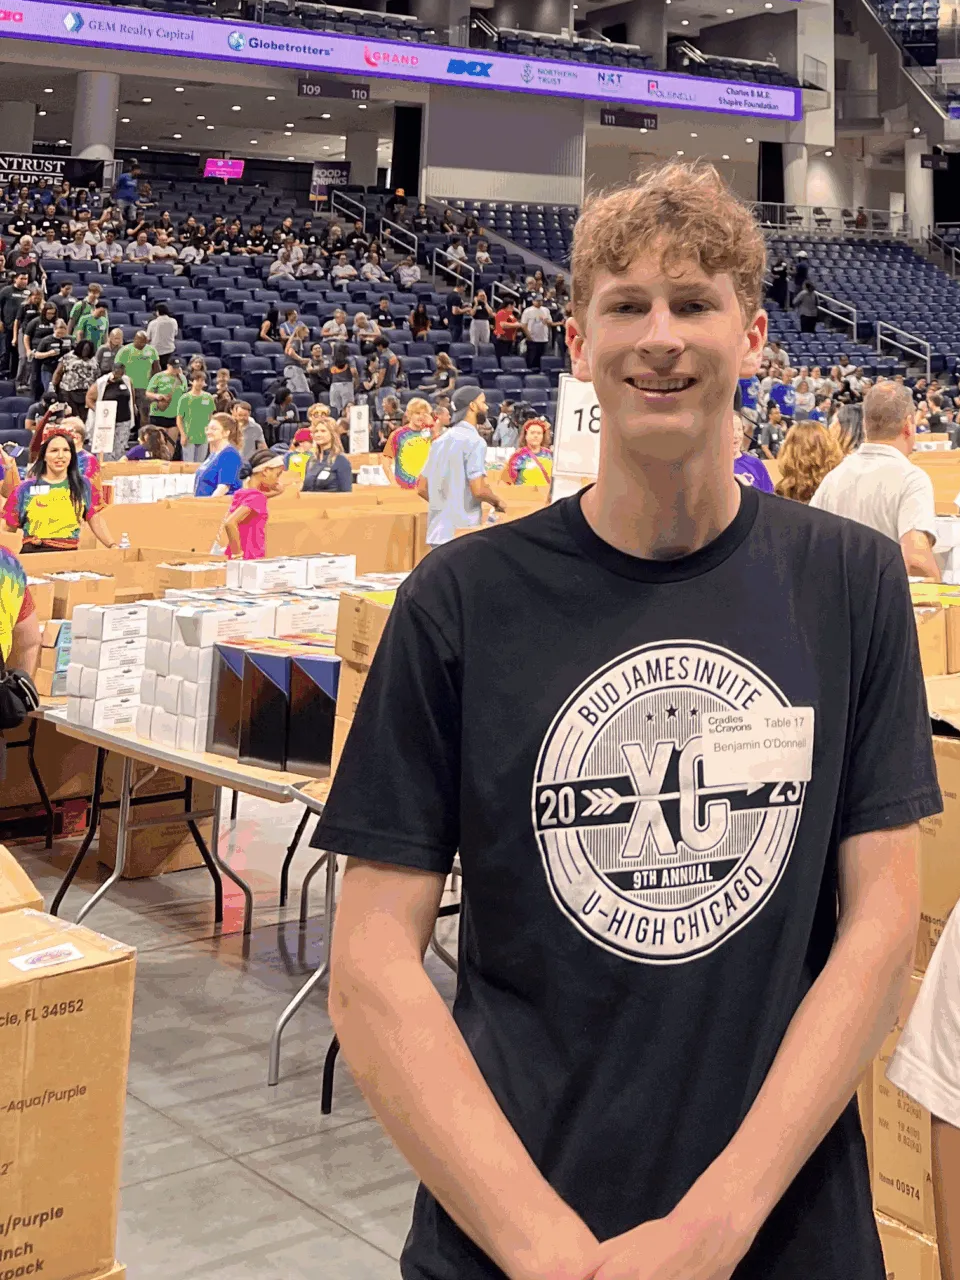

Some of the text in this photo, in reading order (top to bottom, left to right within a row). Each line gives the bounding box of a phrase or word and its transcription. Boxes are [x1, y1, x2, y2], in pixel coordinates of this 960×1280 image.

[88, 20, 195, 44] GEM Realty Capital
[372, 51, 419, 66] GRAND
[537, 77, 562, 86] TRUST
[597, 72, 623, 83] NXT
[301, 84, 367, 100] 109 110
[604, 114, 656, 128] 111 112
[574, 404, 600, 434] 18
[578, 655, 763, 727] BUD JAMES INVITE
[708, 715, 744, 725] Cradles
[764, 717, 805, 728] Table 17
[713, 738, 807, 753] Benjamin O'Donnell
[539, 786, 577, 826] 20
[633, 862, 714, 889] 9TH ANNUAL
[581, 864, 763, 946] U-HIGH CHICAGO
[25, 999, 84, 1022] FL 34952
[896, 1178, 921, 1201] 00974
